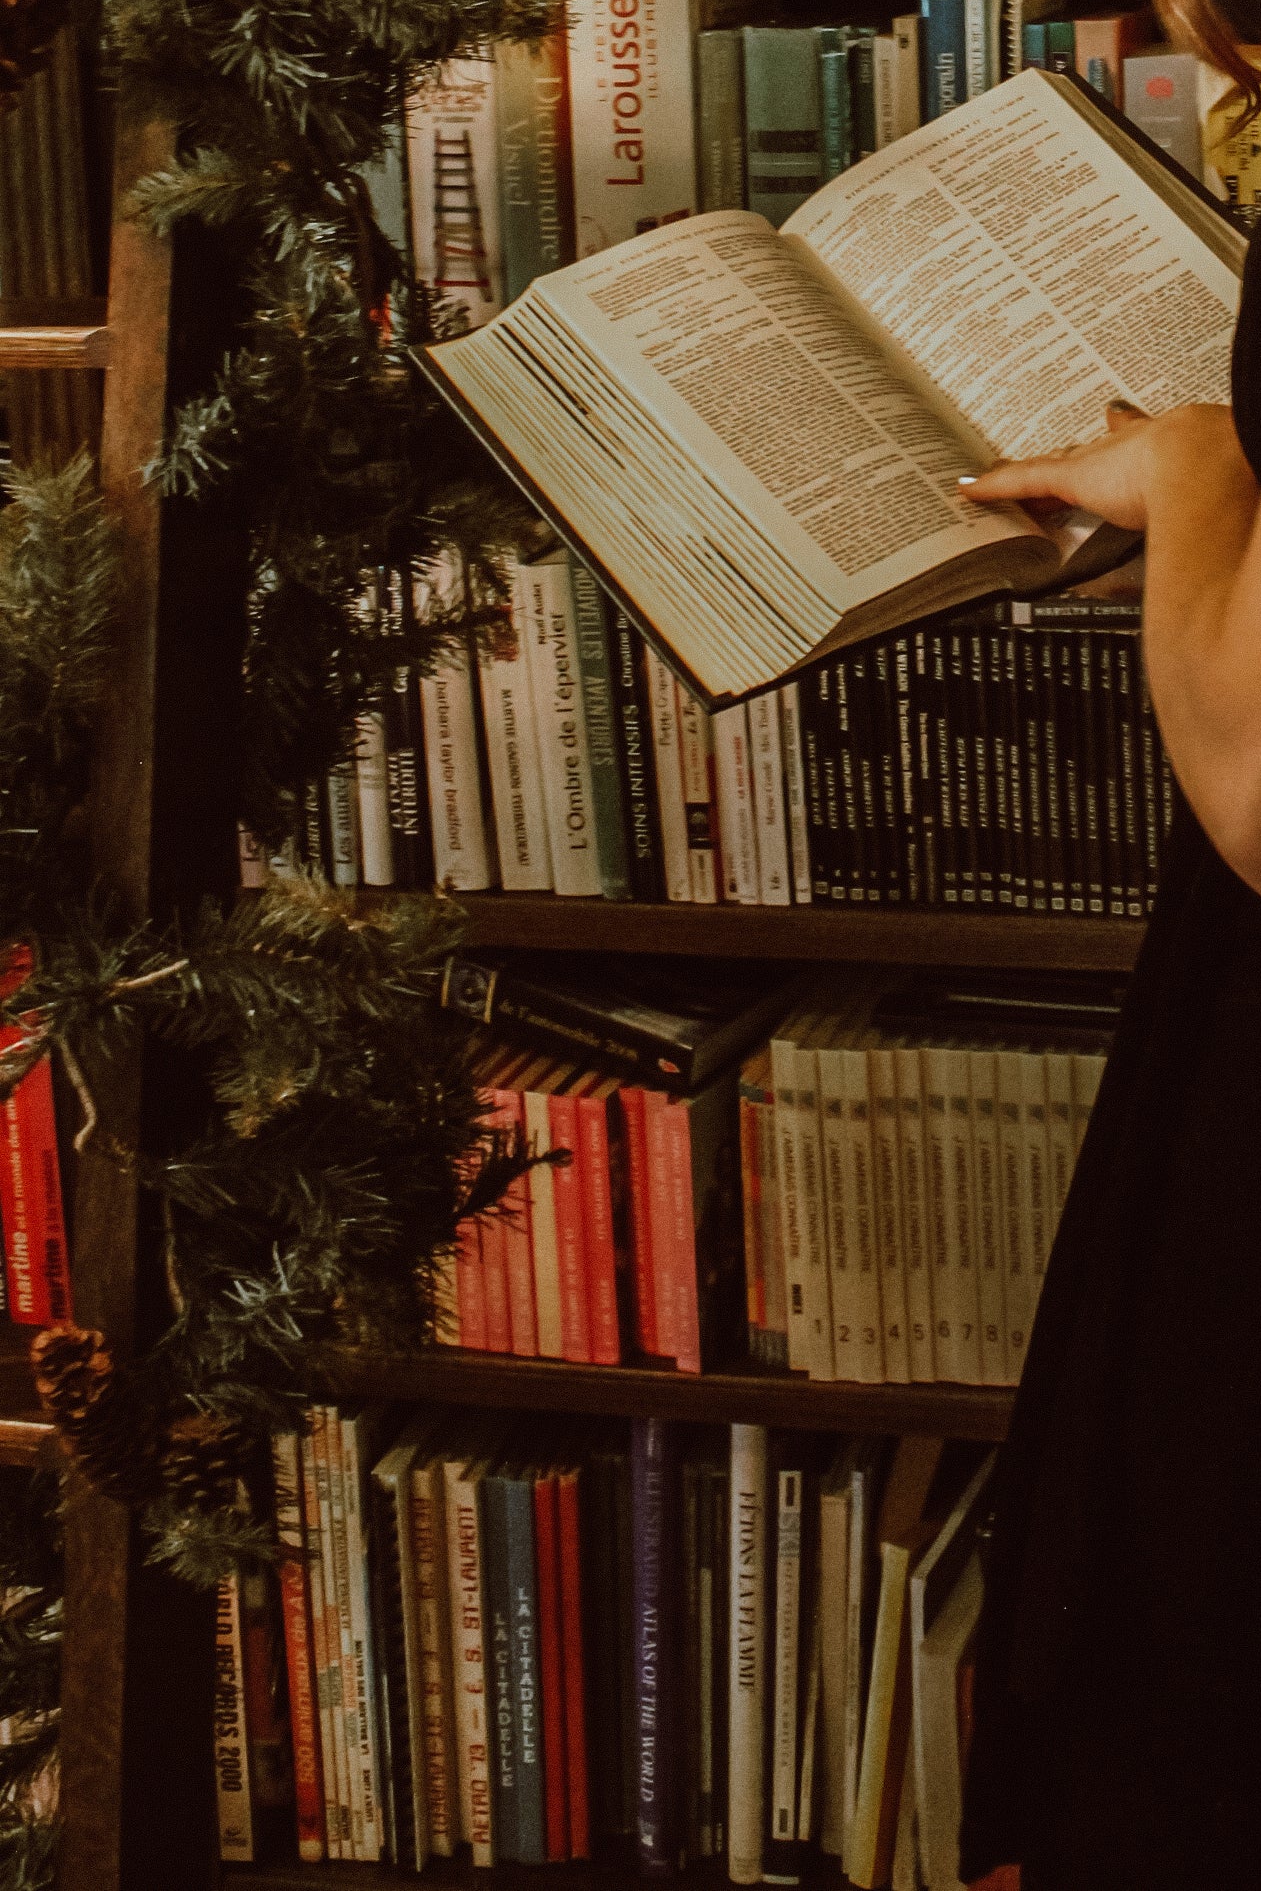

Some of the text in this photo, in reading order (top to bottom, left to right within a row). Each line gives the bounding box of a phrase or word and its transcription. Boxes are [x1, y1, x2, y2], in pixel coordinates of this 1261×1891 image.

[504, 119, 529, 207] Visuel
[534, 77, 564, 259] Dictionnaire
[532, 583, 545, 615] Audet
[574, 567, 614, 766] NOUVELLES AVENTURES
[896, 653, 909, 691] WILSON
[548, 611, 587, 850] L'Ombre de l'épervier
[618, 631, 651, 859] SOINS INTENSIFS Chrystine
[434, 680, 462, 851] barbara taylor bradford
[400, 748, 418, 835] INTERDITE
[6, 1123, 20, 1148] des
[9, 1152, 23, 1197] monde
[9, 1231, 34, 1313] martine
[44, 1239, 66, 1319] martine
[792, 1284, 803, 1315] INDEX
[814, 1319, 822, 1334] 1
[839, 1326, 850, 1342] 2
[864, 1328, 874, 1345] 3
[889, 1325, 900, 1339] 4
[913, 1324, 924, 1340] 5
[939, 1322, 949, 1337] 6
[962, 1324, 972, 1340] 7
[986, 1325, 998, 1341] 8
[1013, 1331, 1024, 1348] 9
[780, 1512, 800, 1555] SKI
[737, 1490, 762, 1694] FÊTONS LA FLAMME
[639, 1602, 658, 1661] ATLAS
[215, 1644, 239, 1738] RECORDS
[289, 1597, 315, 1783] 500 animaux de A
[456, 1506, 488, 1844] RETRO ST-LAURENT
[517, 1587, 537, 1764] LA CITADELLE
[639, 1664, 657, 1689] OF
[494, 1613, 515, 1788] LA CITADELLE
[638, 1695, 658, 1731] THE
[220, 1746, 242, 1793] 2000
[638, 1735, 657, 1802] WORLD
